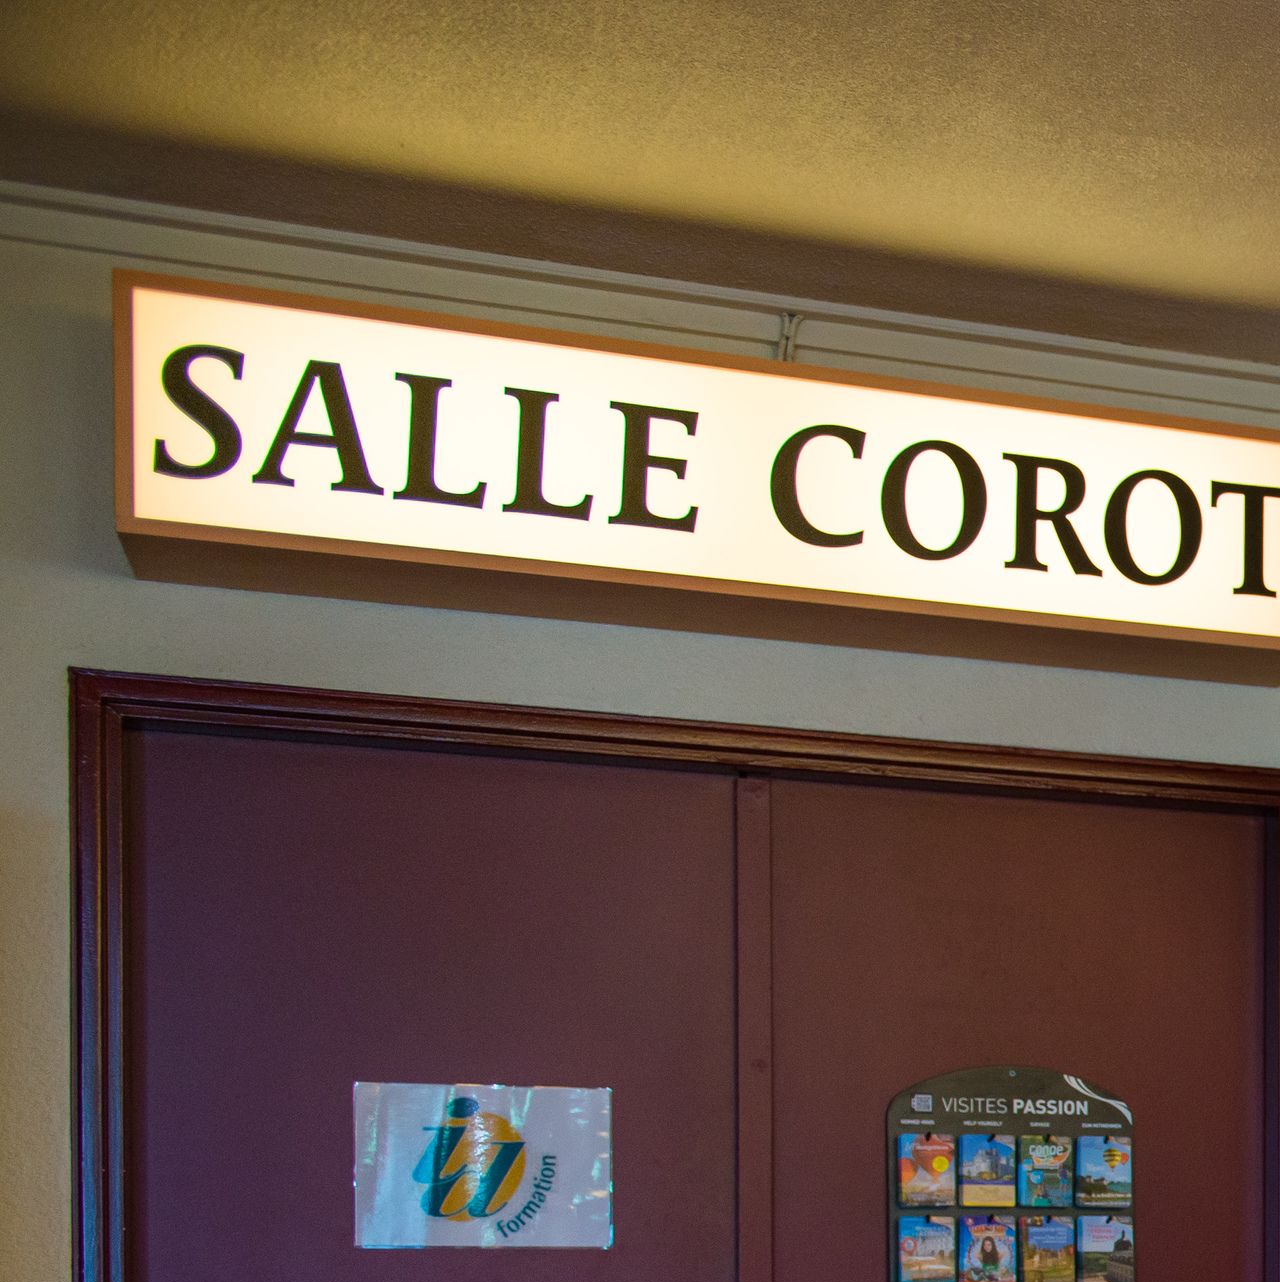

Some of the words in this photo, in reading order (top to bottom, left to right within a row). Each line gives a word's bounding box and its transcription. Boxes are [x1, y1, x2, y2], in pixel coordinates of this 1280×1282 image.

[153, 344, 699, 533] SALLE
[941, 1096, 1008, 1114] VISITES
[1012, 1098, 1089, 1116] PASSION
[495, 1154, 558, 1239] formation
